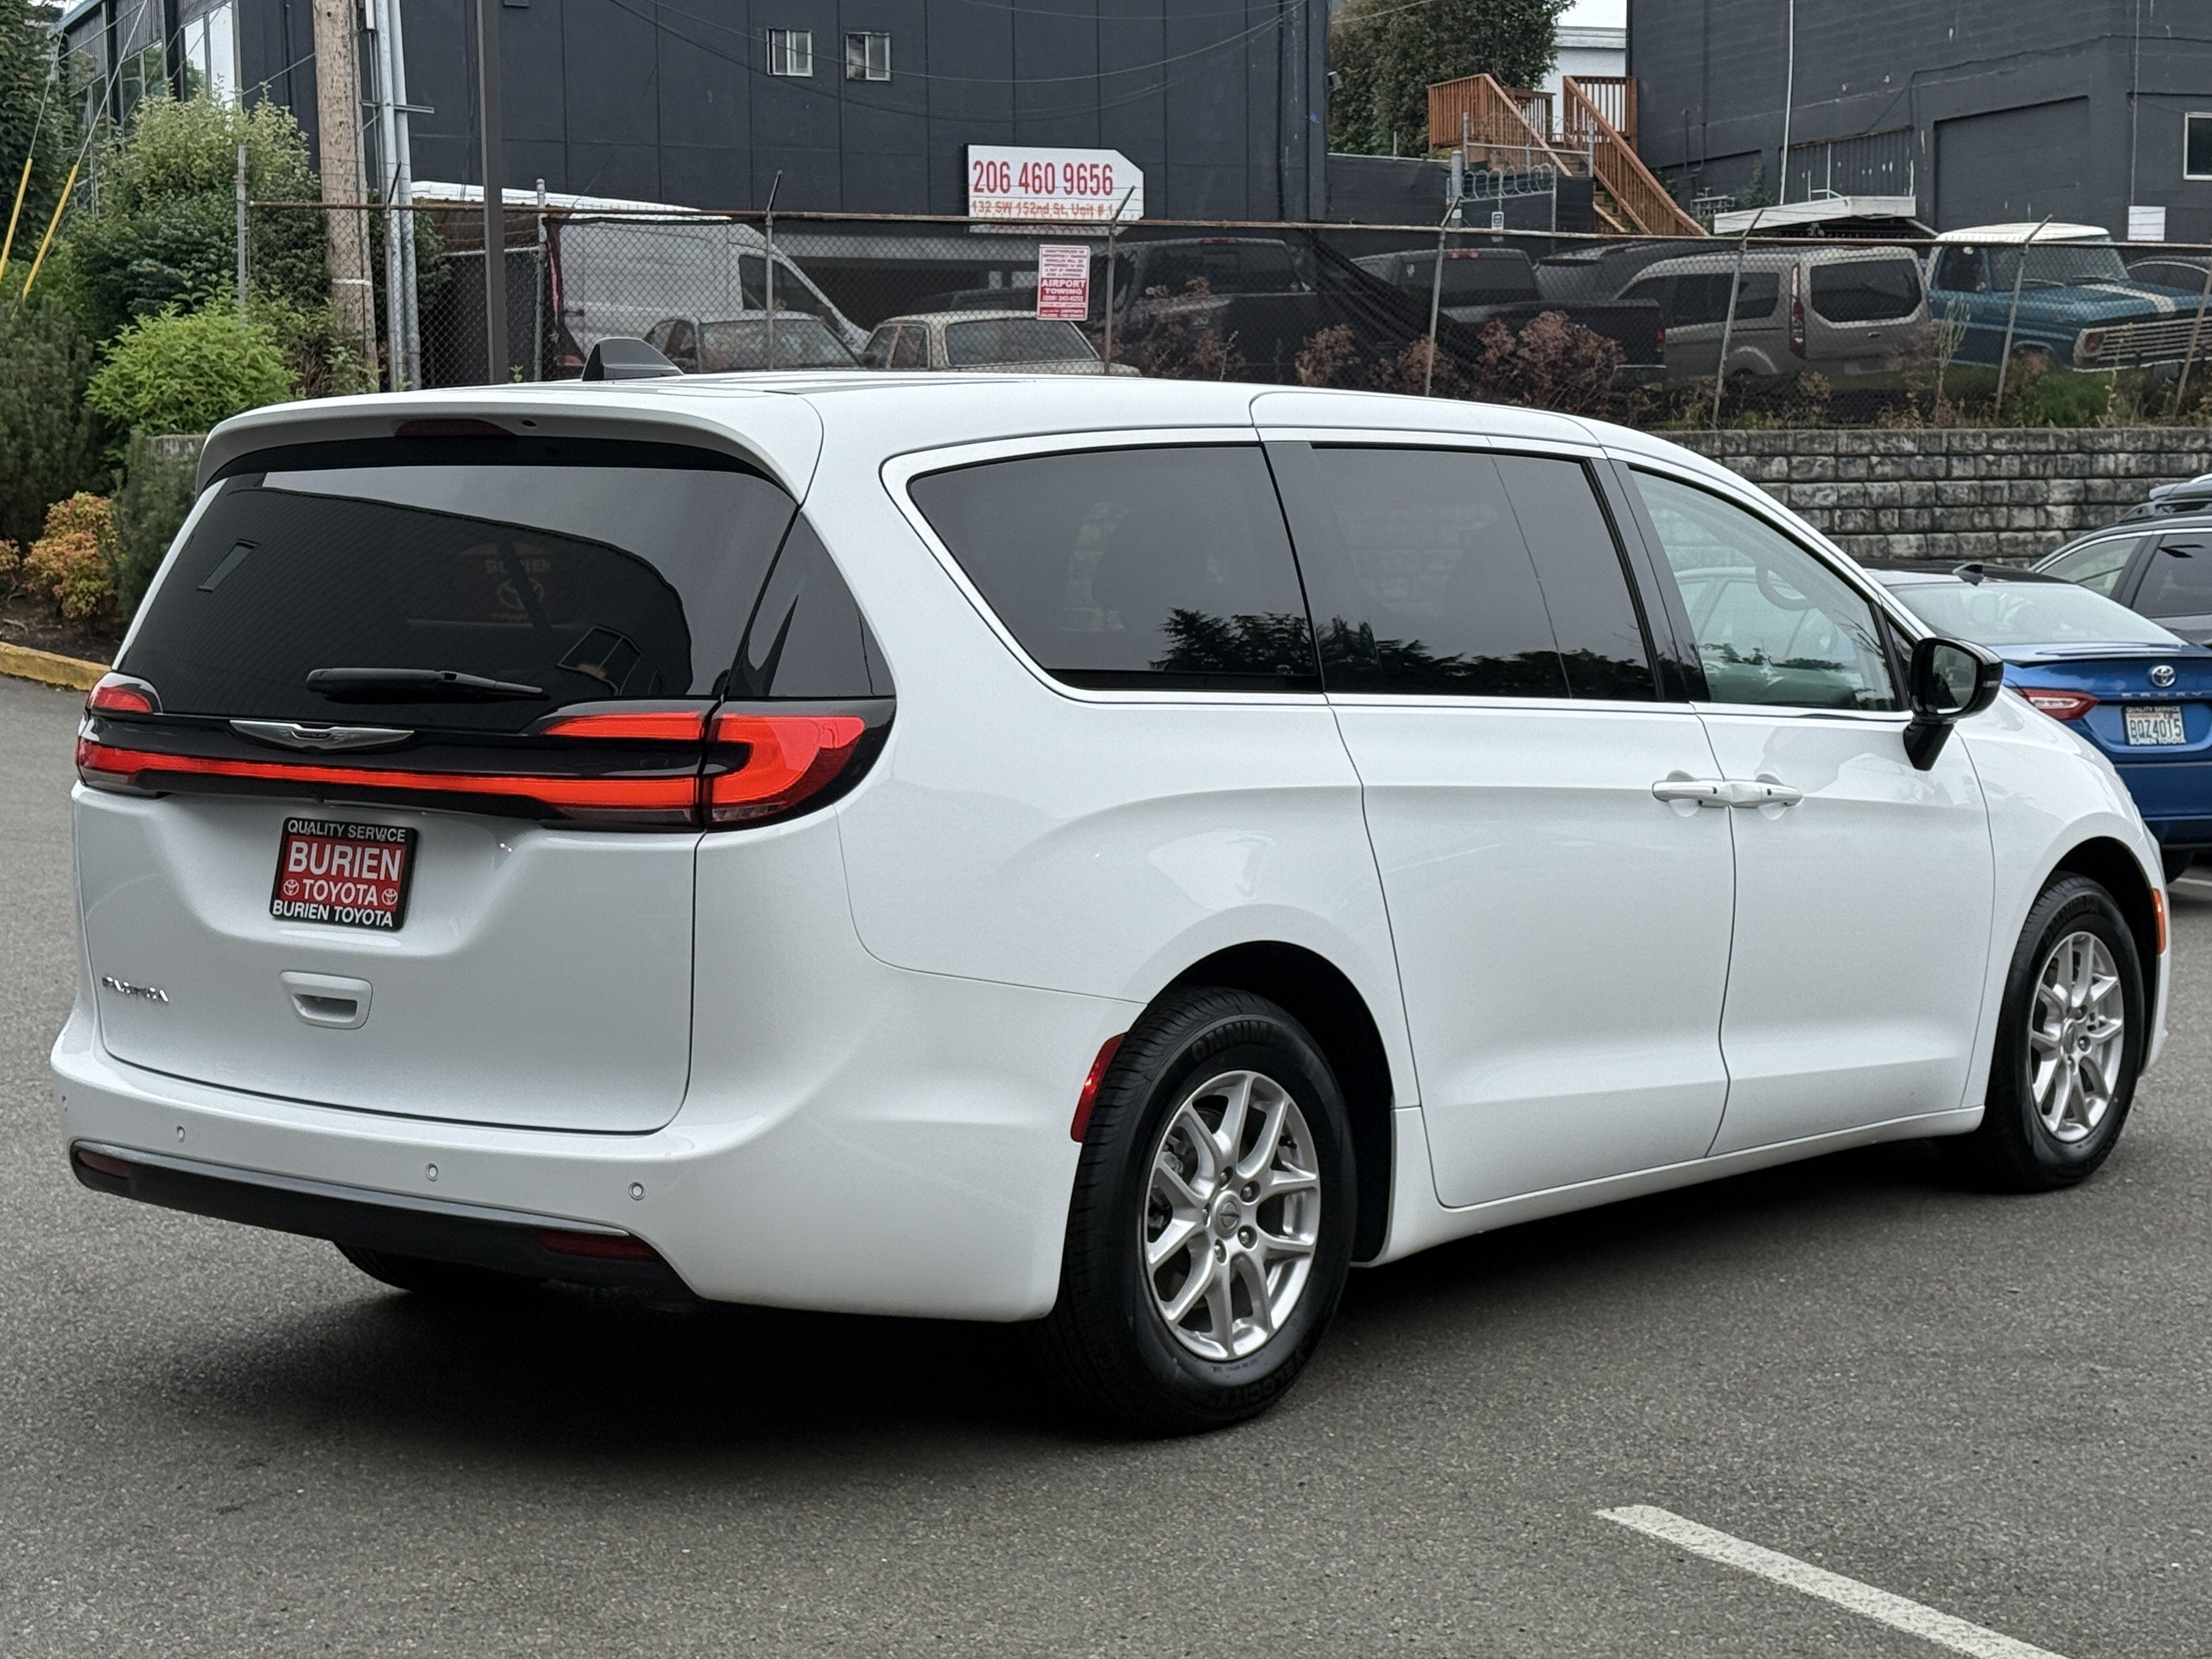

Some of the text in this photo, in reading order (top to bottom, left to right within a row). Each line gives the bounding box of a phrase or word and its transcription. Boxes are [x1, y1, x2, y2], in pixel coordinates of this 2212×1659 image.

[973, 160, 1113, 196] 206 460 9656
[972, 200, 992, 213] 132
[995, 201, 1012, 214] SW
[1017, 202, 1049, 215] 152nd
[1071, 204, 1094, 216] Unit
[1042, 279, 1086, 289] AIRPORT
[288, 820, 406, 842] QUALITY SERVICE
[288, 841, 401, 881] BURIEN
[303, 879, 378, 906] TOYOTA
[273, 900, 393, 927] BURIEN TOYOTA
